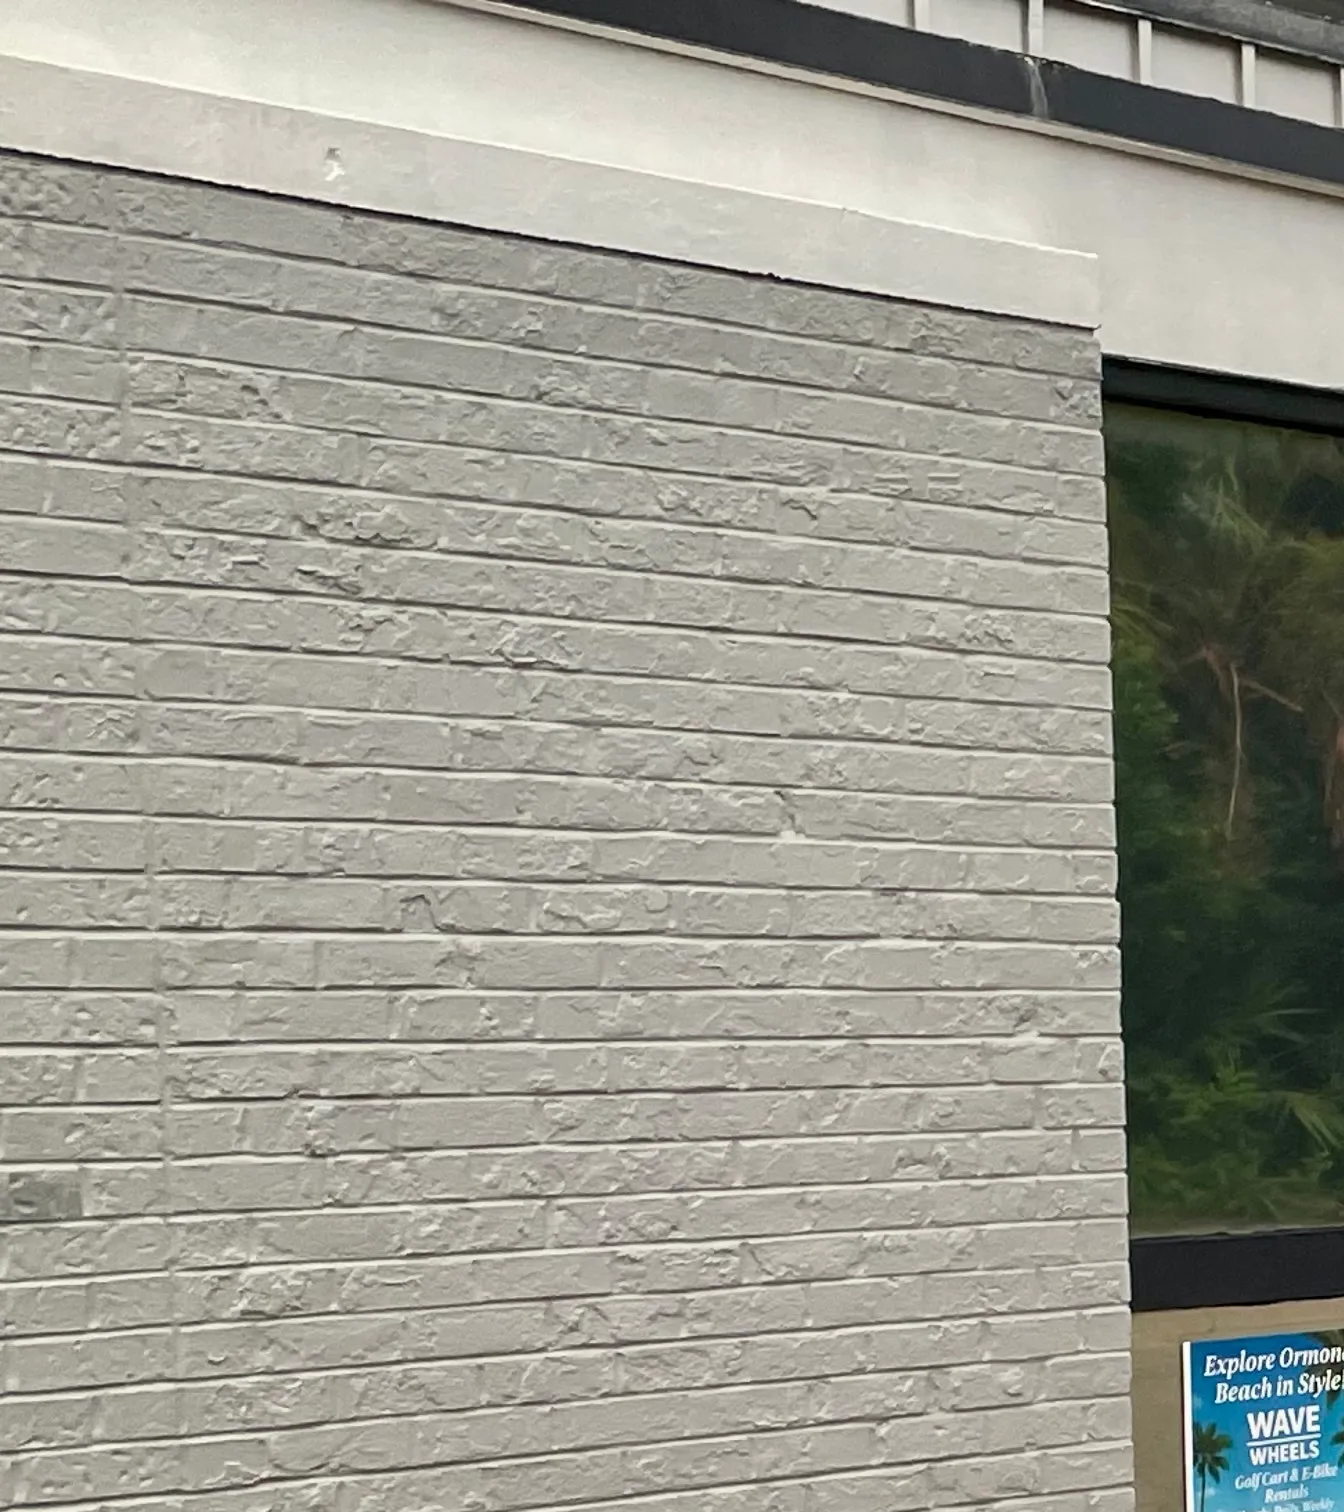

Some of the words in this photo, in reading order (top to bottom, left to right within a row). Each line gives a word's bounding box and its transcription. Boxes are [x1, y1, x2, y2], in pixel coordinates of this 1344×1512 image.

[1204, 1349, 1276, 1380] Explore
[1214, 1376, 1272, 1404] Beach
[1276, 1375, 1293, 1400] in
[1246, 1404, 1321, 1439] WAVE
[1249, 1440, 1320, 1466] WHEELS
[1235, 1471, 1263, 1491] Golf
[1261, 1470, 1288, 1486] Cart
